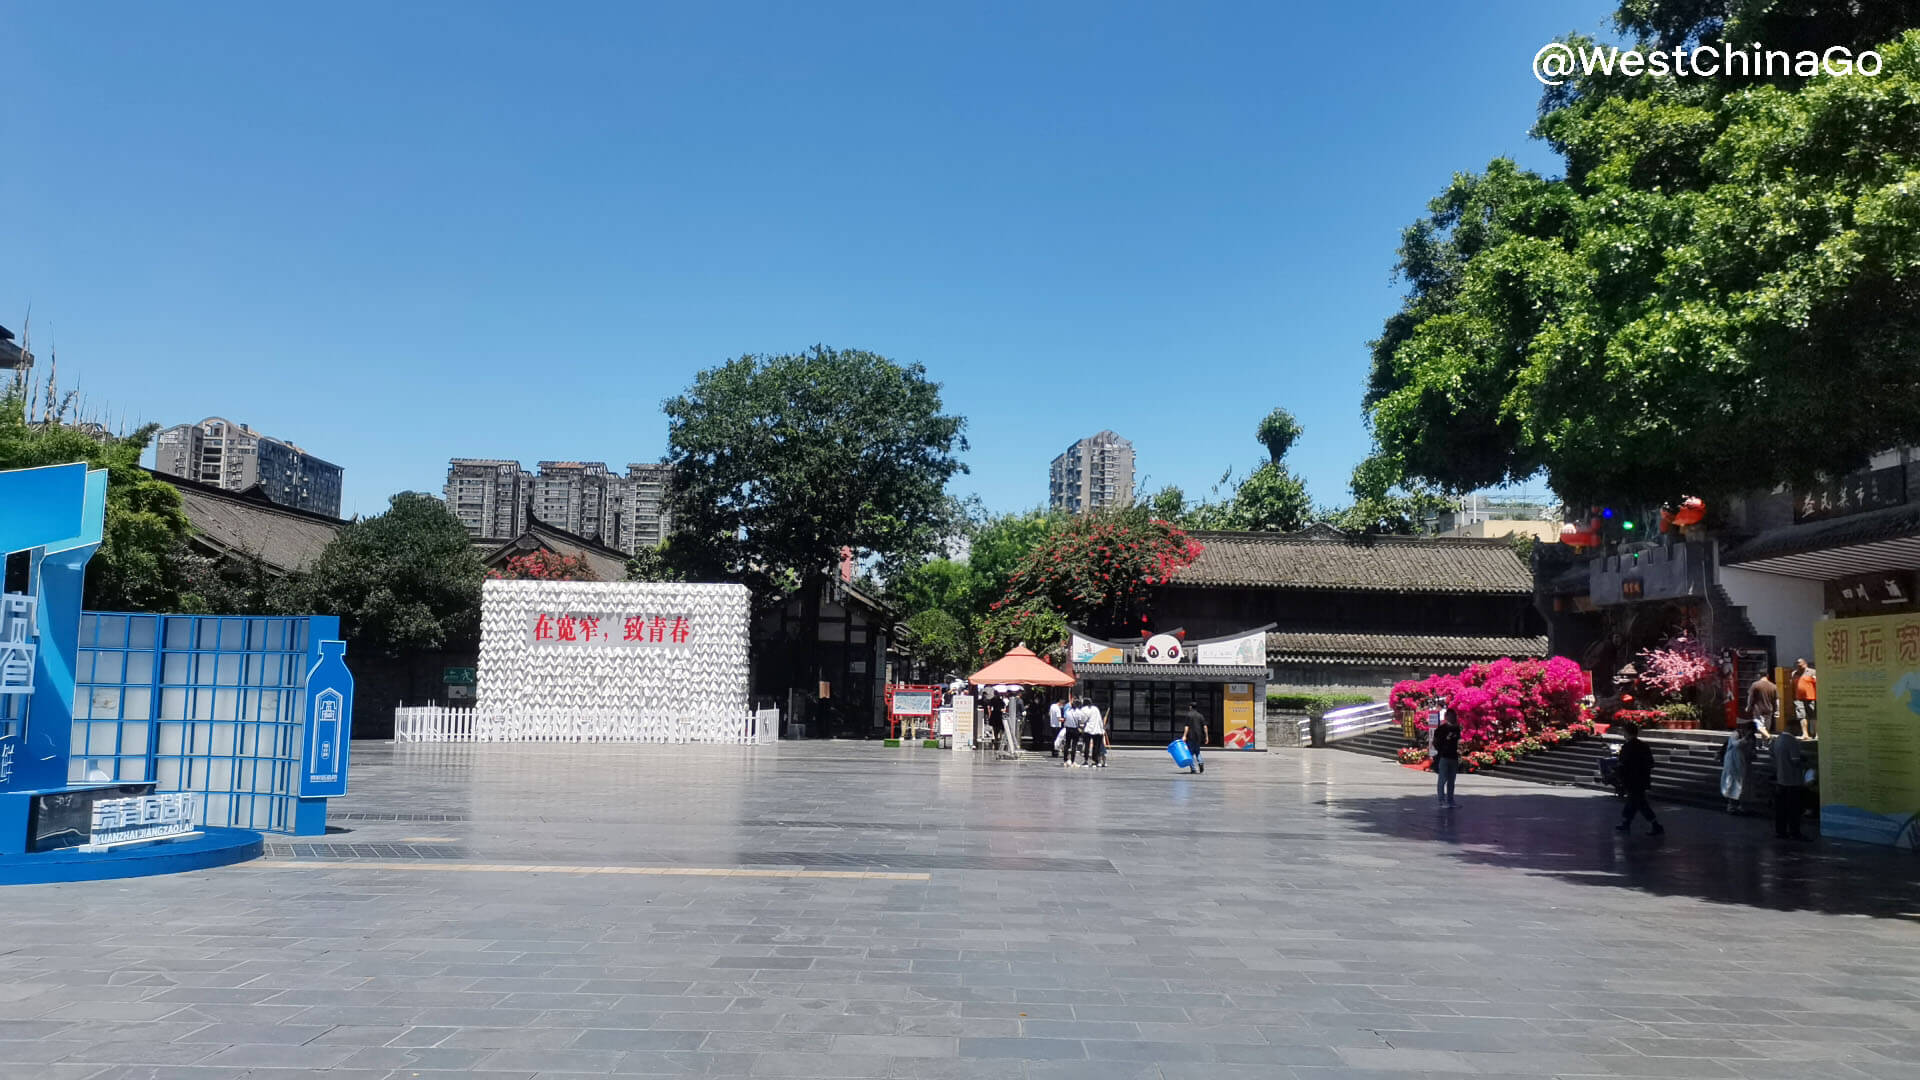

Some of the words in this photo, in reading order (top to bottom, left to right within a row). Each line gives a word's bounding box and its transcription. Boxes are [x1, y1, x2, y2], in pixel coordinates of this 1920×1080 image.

[533, 613, 690, 643] 在宽窄，致青春
[1826, 625, 1920, 664] 潮玩宽
[95, 829, 138, 844] KUANZHAI
